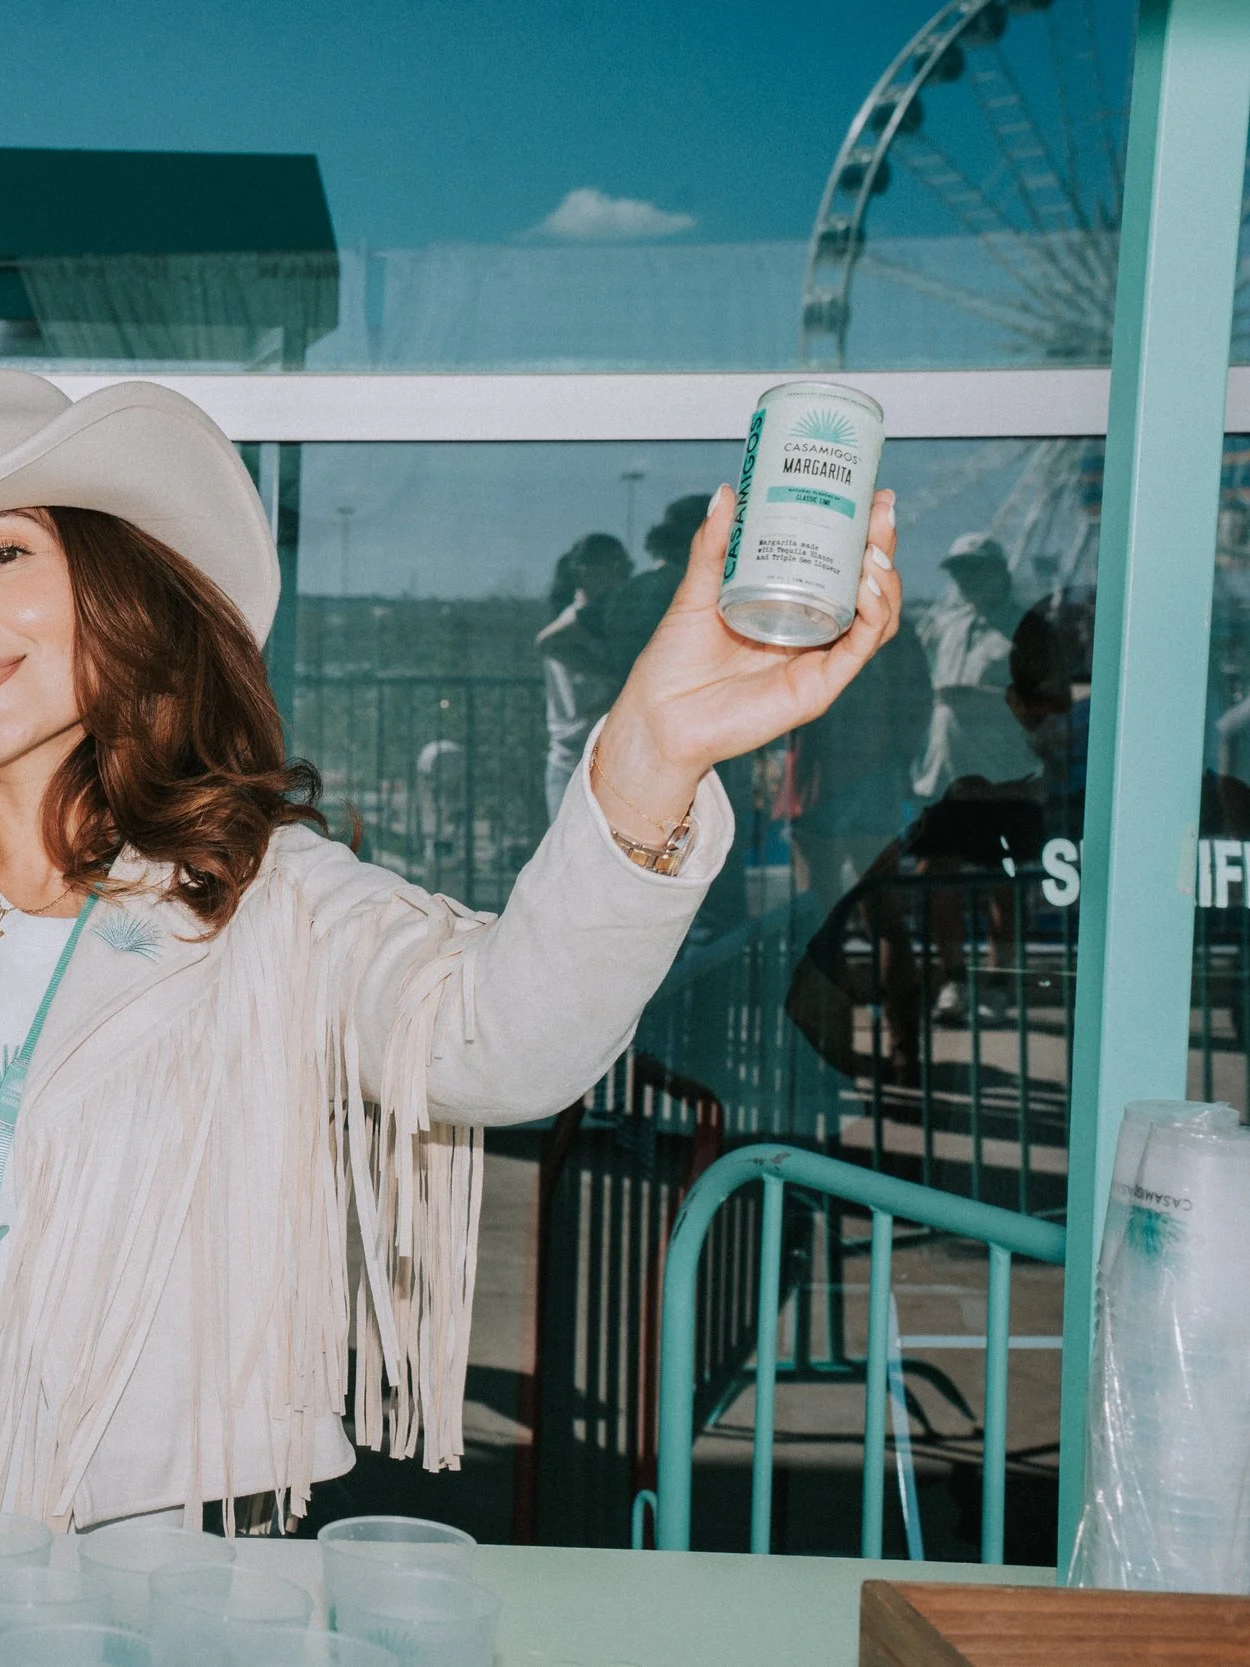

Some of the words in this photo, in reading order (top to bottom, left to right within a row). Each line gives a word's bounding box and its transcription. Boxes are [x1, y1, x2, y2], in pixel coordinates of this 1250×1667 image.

[782, 458, 852, 486] MARGARITA
[723, 416, 763, 580] CASAMIGOS
[758, 539, 797, 547] Margarita
[800, 542, 820, 551] made
[777, 547, 807, 556] Tequila
[772, 554, 797, 562] Triple
